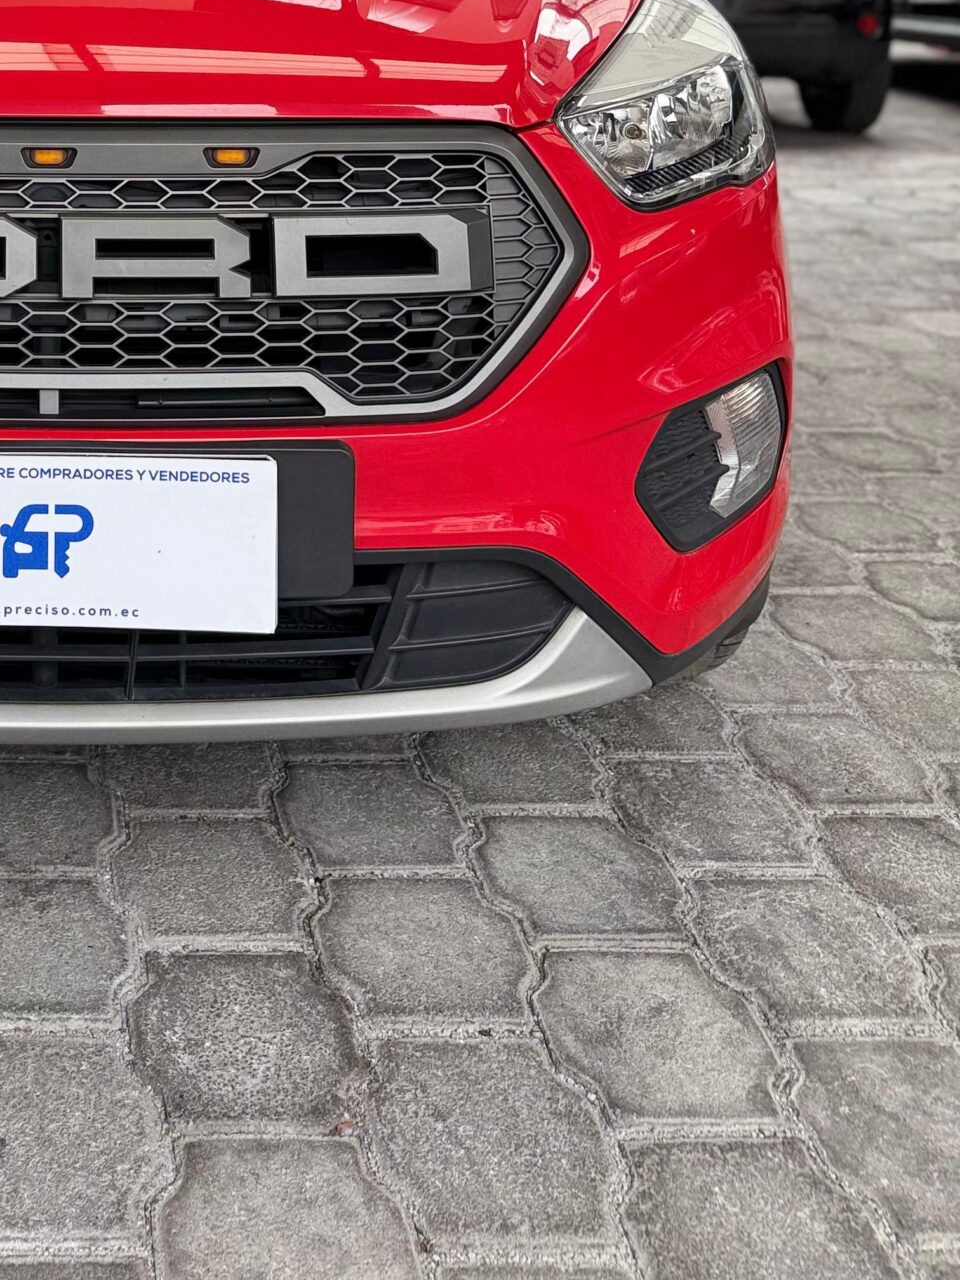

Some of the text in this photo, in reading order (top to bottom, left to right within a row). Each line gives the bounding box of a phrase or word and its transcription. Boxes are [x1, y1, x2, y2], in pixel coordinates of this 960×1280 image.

[18, 467, 134, 481] COMPRADORES
[136, 469, 146, 481] Y
[149, 469, 251, 484] VENDEDORES
